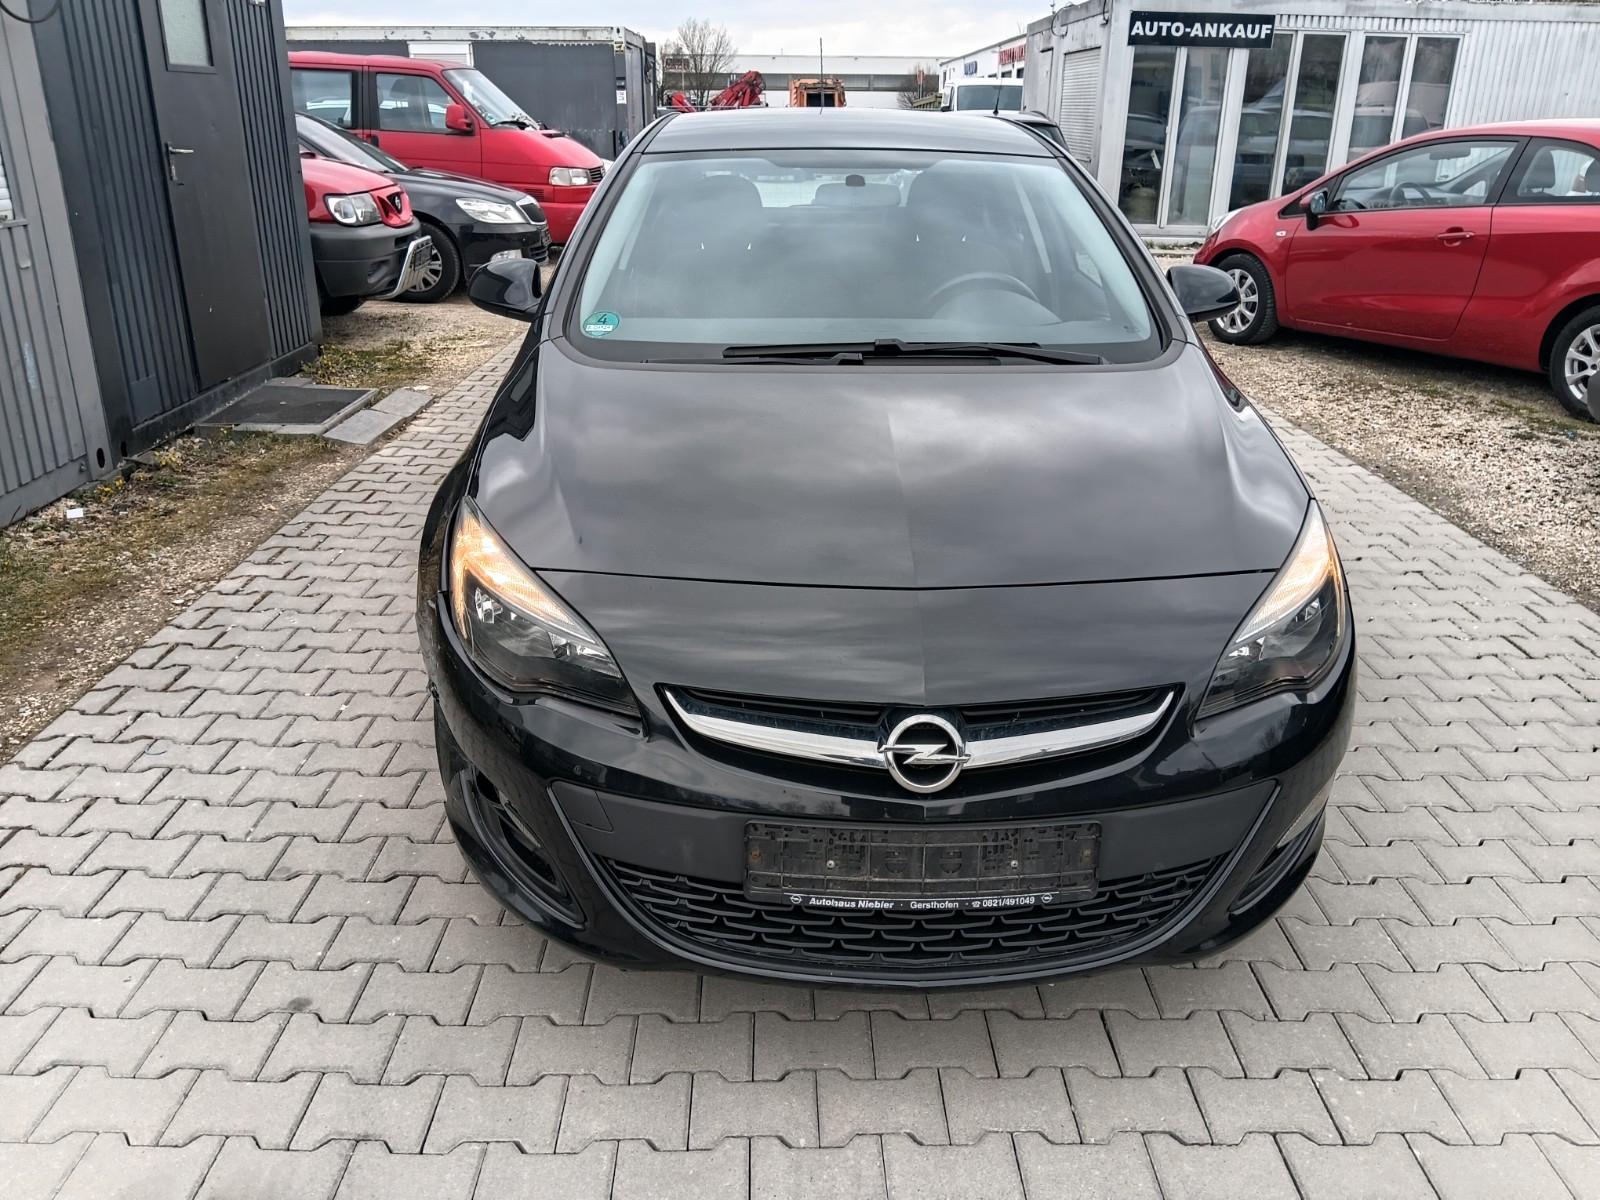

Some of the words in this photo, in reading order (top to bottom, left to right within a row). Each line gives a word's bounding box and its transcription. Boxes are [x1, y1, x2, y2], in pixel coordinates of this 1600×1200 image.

[1131, 21, 1272, 39] AUTO-ANKAUF
[597, 313, 607, 324] 4
[809, 897, 856, 908] Autohaus
[858, 900, 894, 909] Niebler
[910, 901, 959, 909] Gersthofen
[982, 897, 1035, 907] 0821/491049
